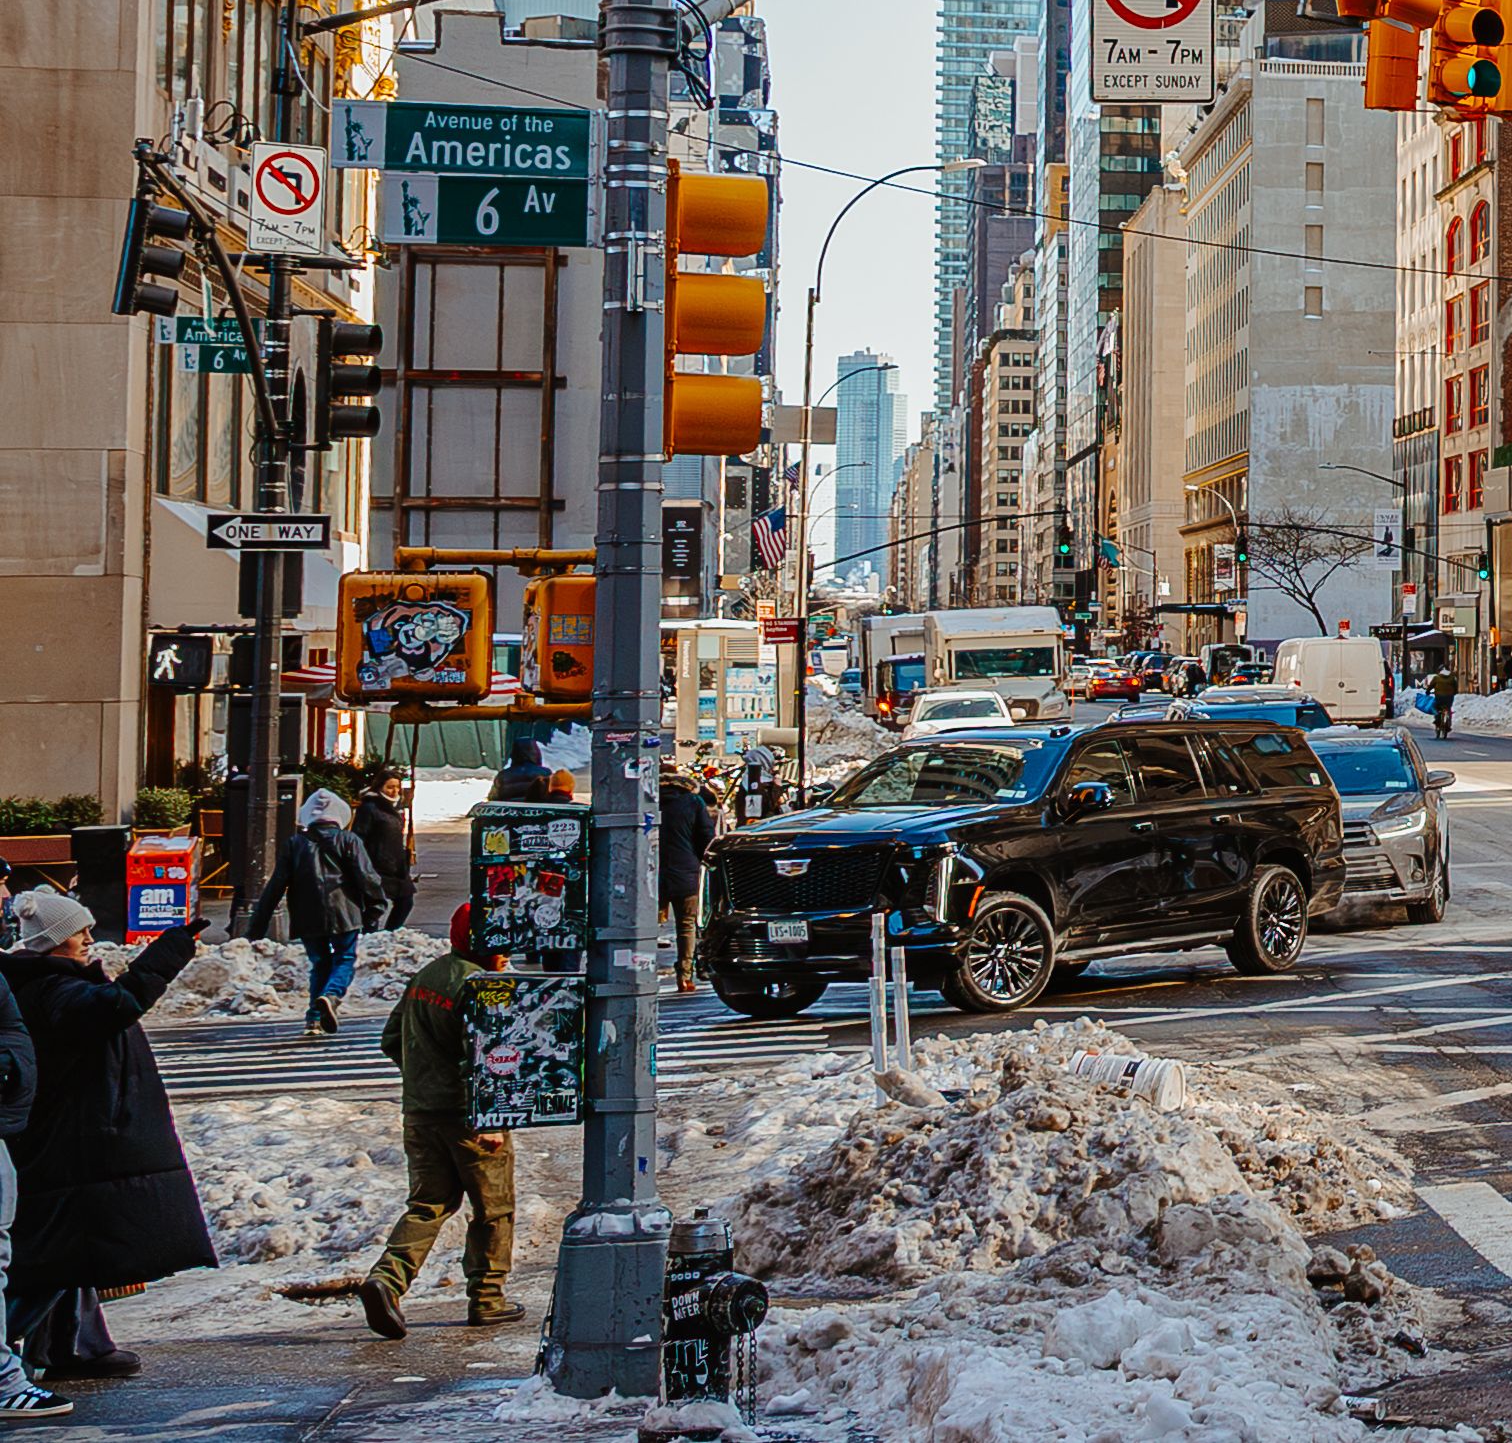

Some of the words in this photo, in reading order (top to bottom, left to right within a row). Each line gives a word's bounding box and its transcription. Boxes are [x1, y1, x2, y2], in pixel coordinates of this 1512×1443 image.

[1103, 39, 1141, 64] 7AM
[1166, 40, 1203, 64] 7PM
[1104, 75, 1149, 88] EXCEPT
[1155, 75, 1202, 89] SUNDAY
[424, 111, 493, 130] Avenue
[500, 115, 518, 131] of
[525, 115, 554, 133] the
[405, 131, 572, 170] Americas
[475, 186, 500, 235] 6
[523, 184, 556, 213] Av
[184, 328, 245, 342] America
[213, 350, 224, 369] 6
[226, 525, 261, 539] ONE
[278, 525, 315, 539] WAY
[551, 822, 577, 832] 223
[140, 888, 175, 904] am
[476, 1112, 528, 1127] MUTZ
[671, 1290, 700, 1309] DOWN
[673, 1303, 700, 1321] MFER
